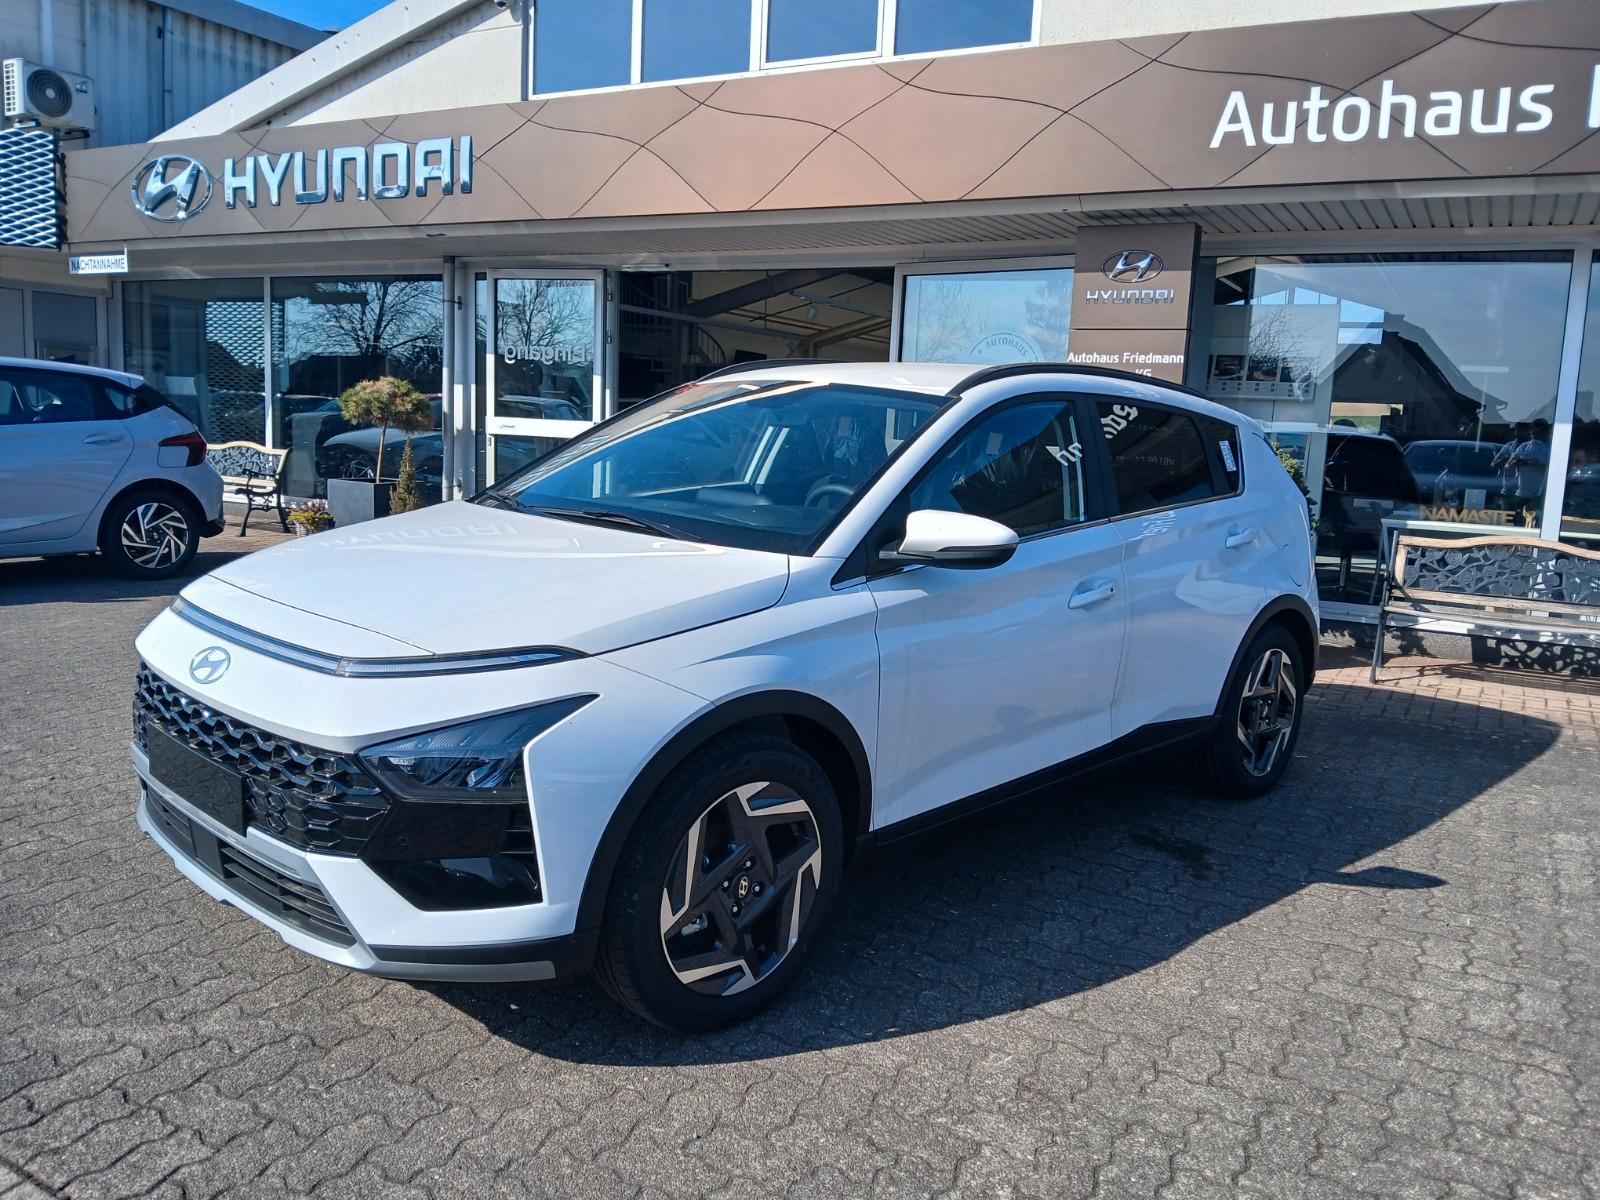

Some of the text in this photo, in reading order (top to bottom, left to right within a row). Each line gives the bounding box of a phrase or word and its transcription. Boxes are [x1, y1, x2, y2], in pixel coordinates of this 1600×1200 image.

[1209, 80, 1555, 149] Autohaus
[223, 135, 474, 209] HYUNDAI
[71, 257, 125, 271] NACHTANNAHME
[1085, 289, 1176, 304] HYUNDAI
[1067, 352, 1184, 364] Autohaus Friedmann
[1135, 368, 1152, 377] KG
[1420, 505, 1516, 526] NAMASTE
